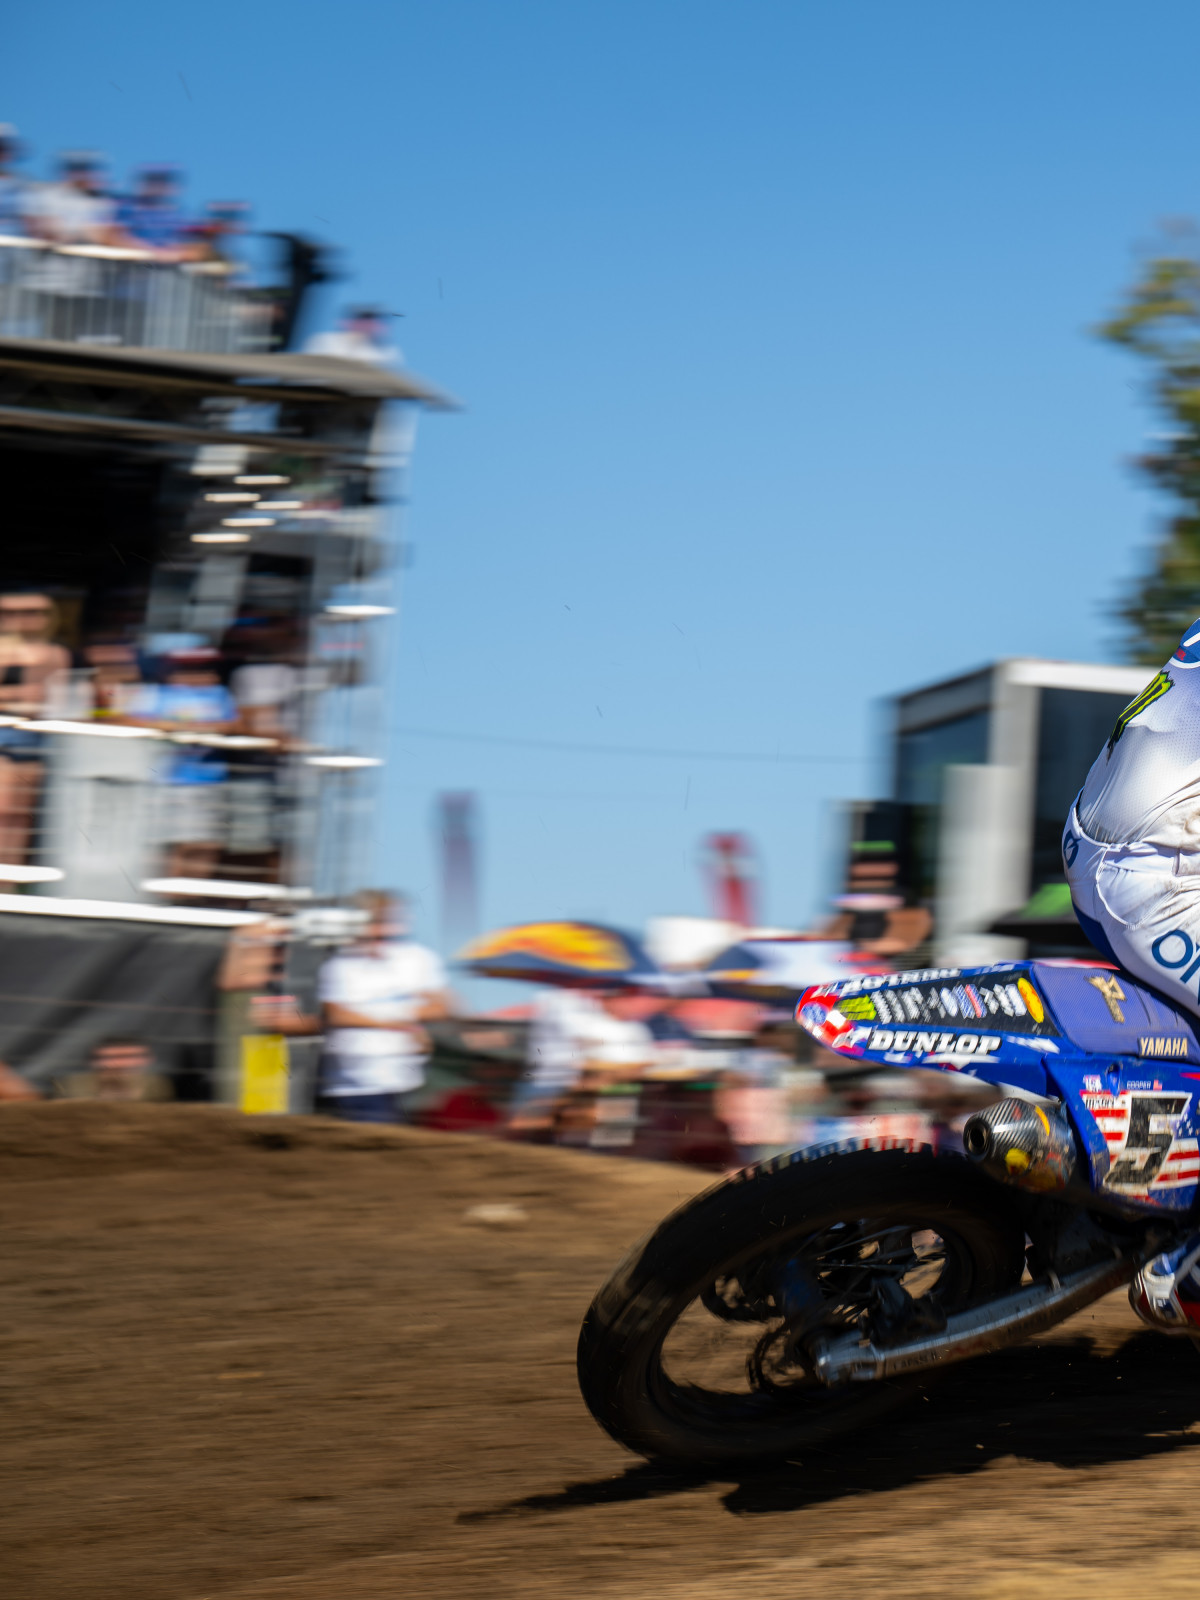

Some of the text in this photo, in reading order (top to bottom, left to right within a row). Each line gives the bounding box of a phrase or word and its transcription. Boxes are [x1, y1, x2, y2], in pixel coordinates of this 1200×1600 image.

[867, 1030, 1002, 1056] DUNLOP
[1139, 1037, 1188, 1056] YAMAHA
[1103, 1092, 1192, 1186] 5
